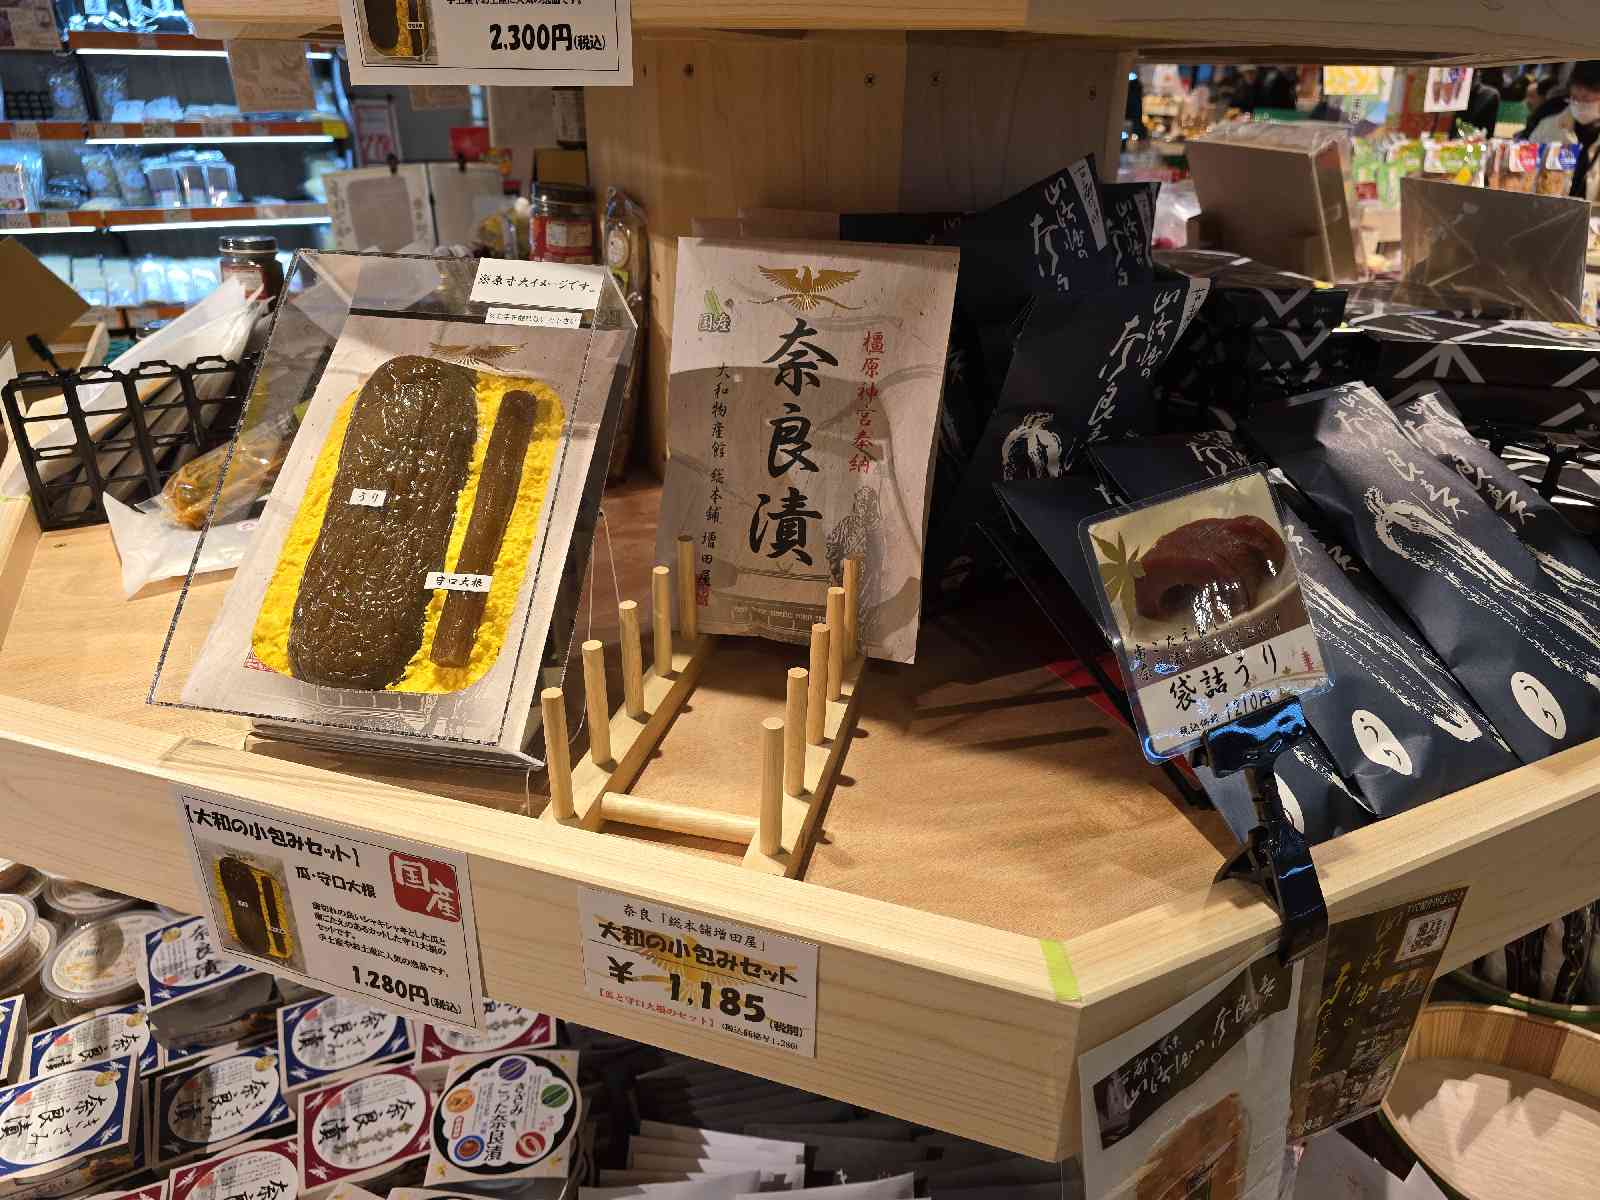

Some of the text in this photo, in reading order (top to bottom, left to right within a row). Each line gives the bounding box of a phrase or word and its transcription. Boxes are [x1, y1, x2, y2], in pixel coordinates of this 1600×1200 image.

[749, 317, 839, 567] 奈良漬
[1169, 644, 1278, 712] 袋詰うり
[295, 866, 377, 898] 瓜・守口大根
[391, 858, 462, 923] 国産
[597, 921, 799, 985] 大和の小包みセット
[607, 955, 635, 985] ¥
[669, 973, 767, 1023] 1,185
